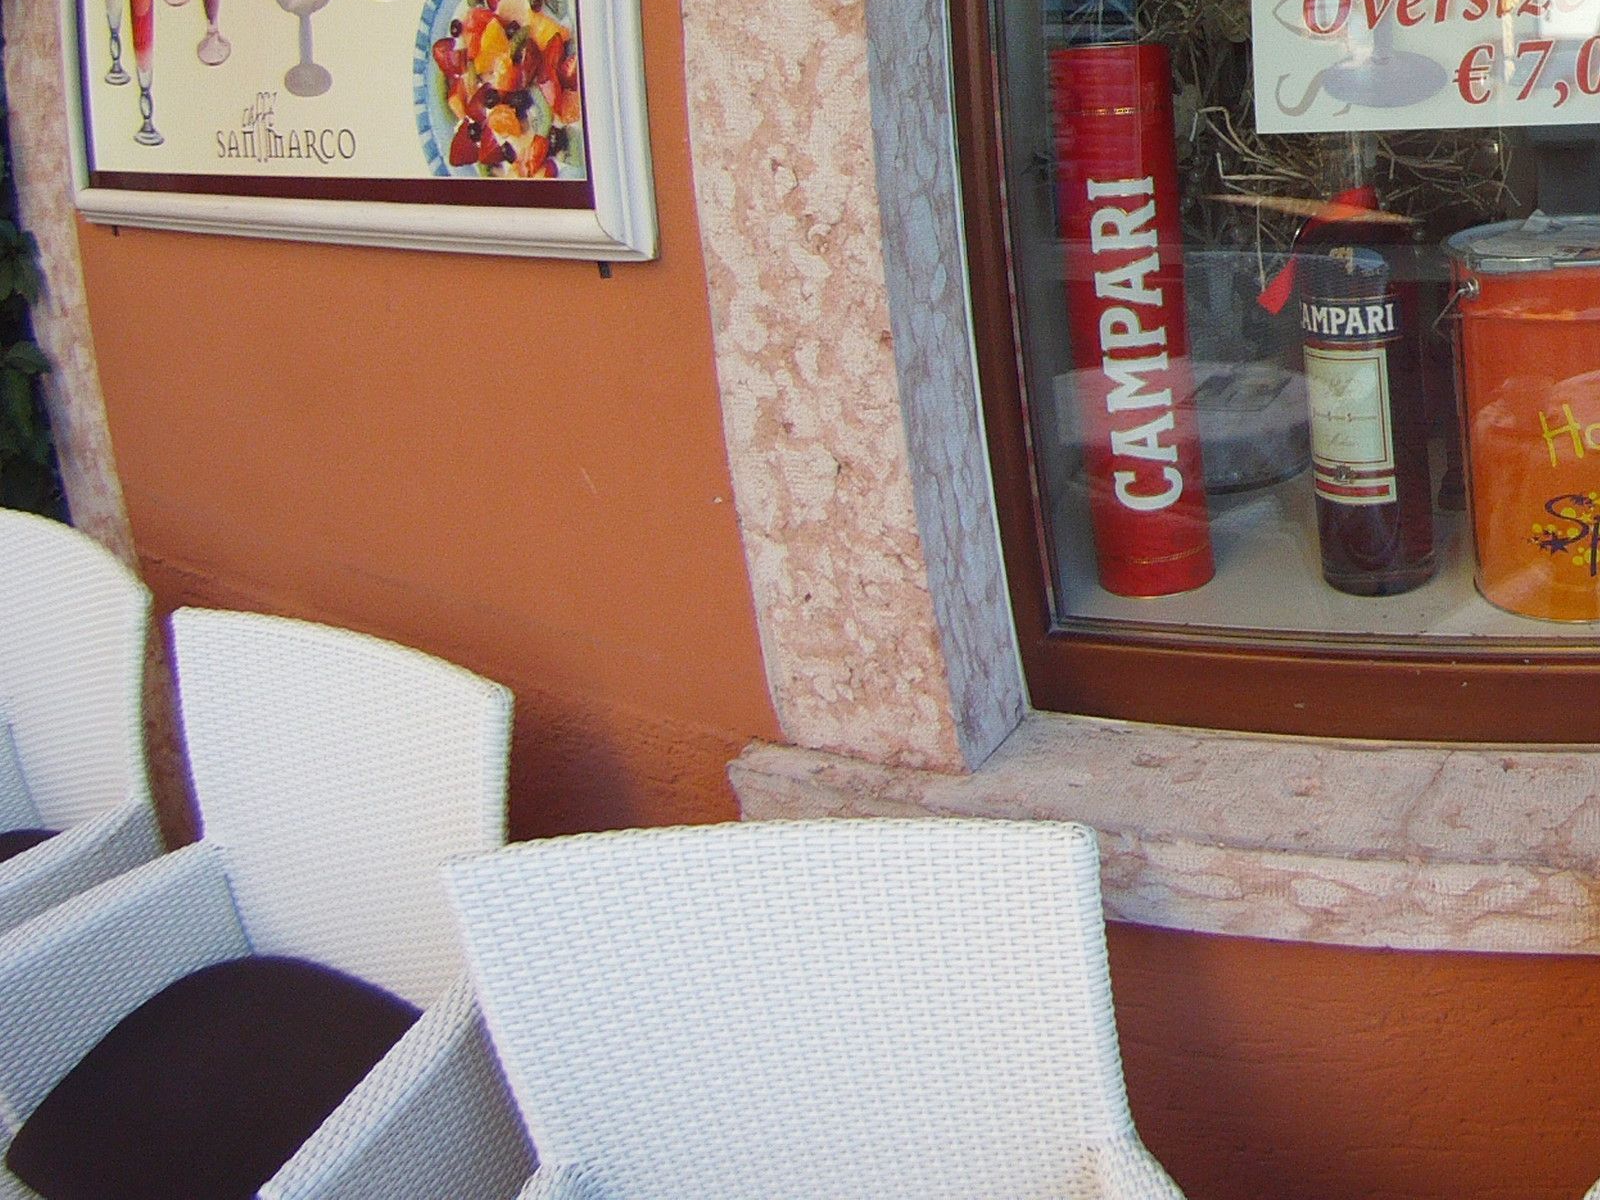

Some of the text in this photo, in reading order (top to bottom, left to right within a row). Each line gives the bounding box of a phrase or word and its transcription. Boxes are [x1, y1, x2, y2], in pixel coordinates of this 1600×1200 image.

[1452, 44, 1496, 106] €
[1087, 176, 1184, 511] CAMPARI
[1302, 303, 1394, 335] AMPARI
